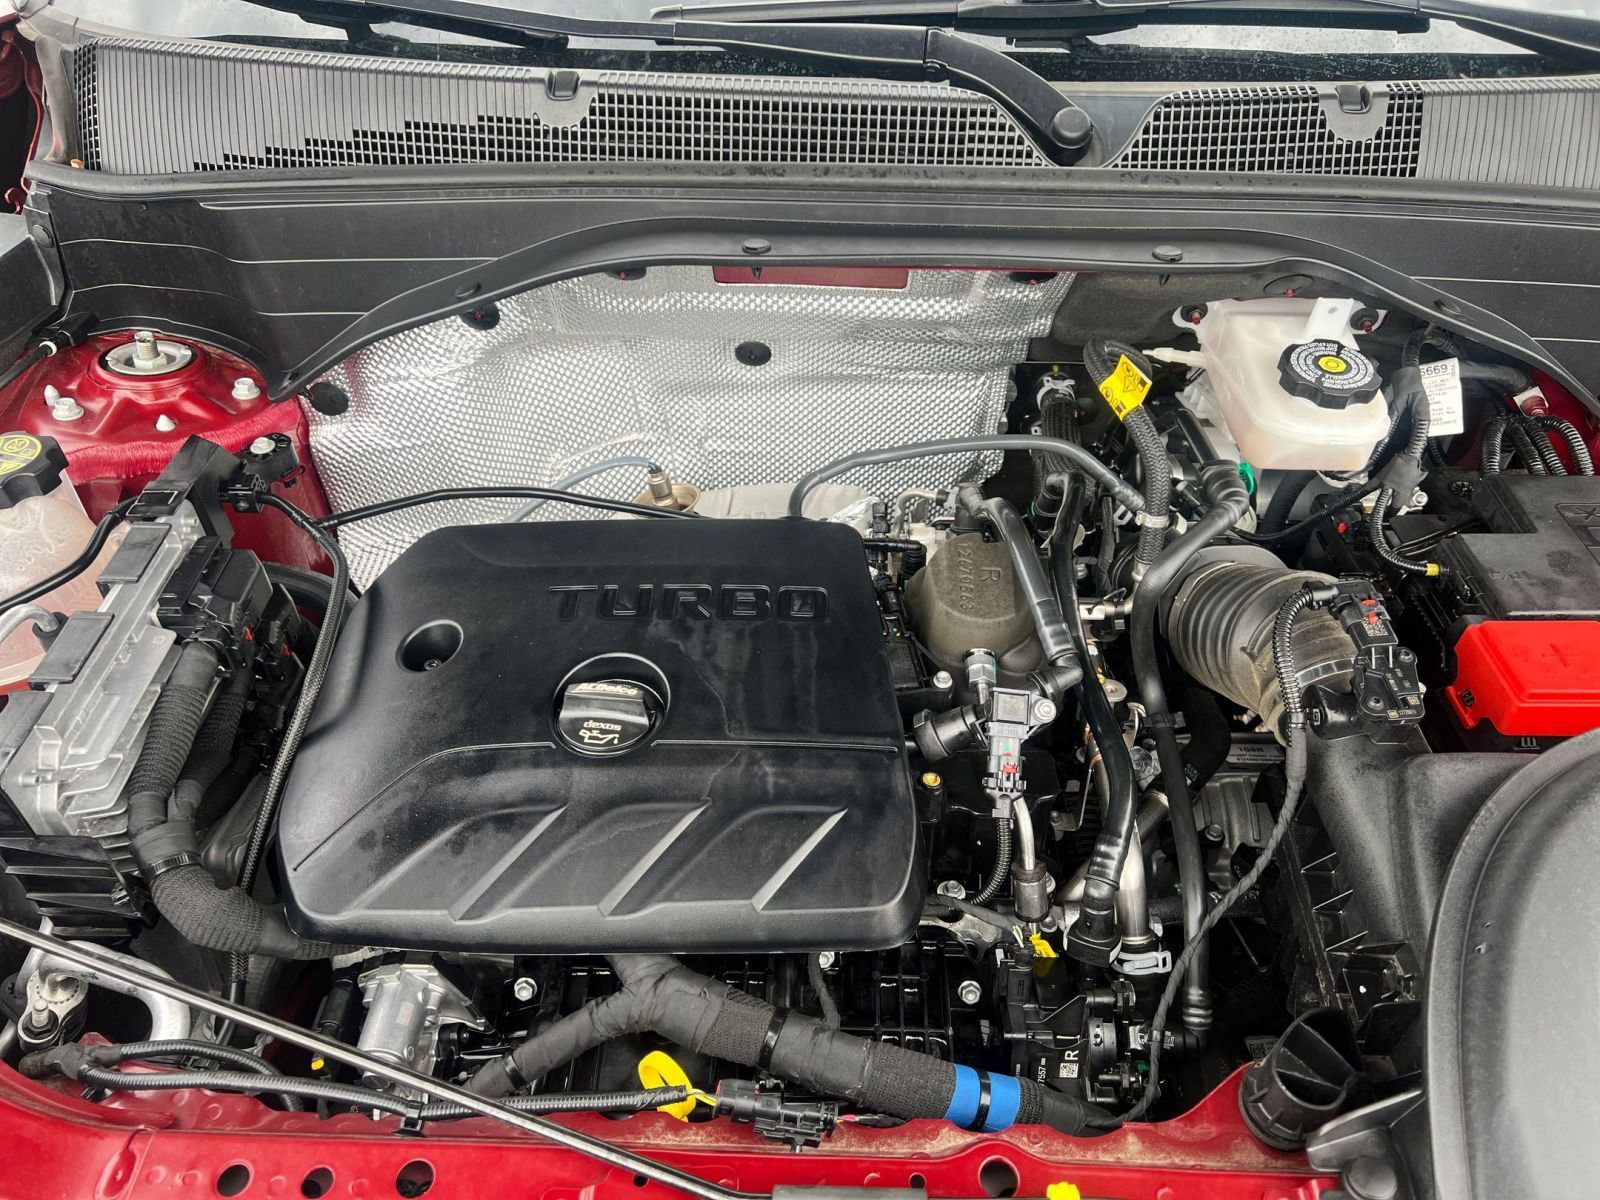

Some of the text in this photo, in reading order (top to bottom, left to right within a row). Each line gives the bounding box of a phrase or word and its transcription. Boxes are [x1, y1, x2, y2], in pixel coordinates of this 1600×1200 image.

[981, 566, 1002, 583] R
[549, 584, 829, 621] TURBO
[575, 683, 638, 696] ACDelco
[583, 719, 623, 731] dexos
[1064, 1050, 1079, 1060] R
